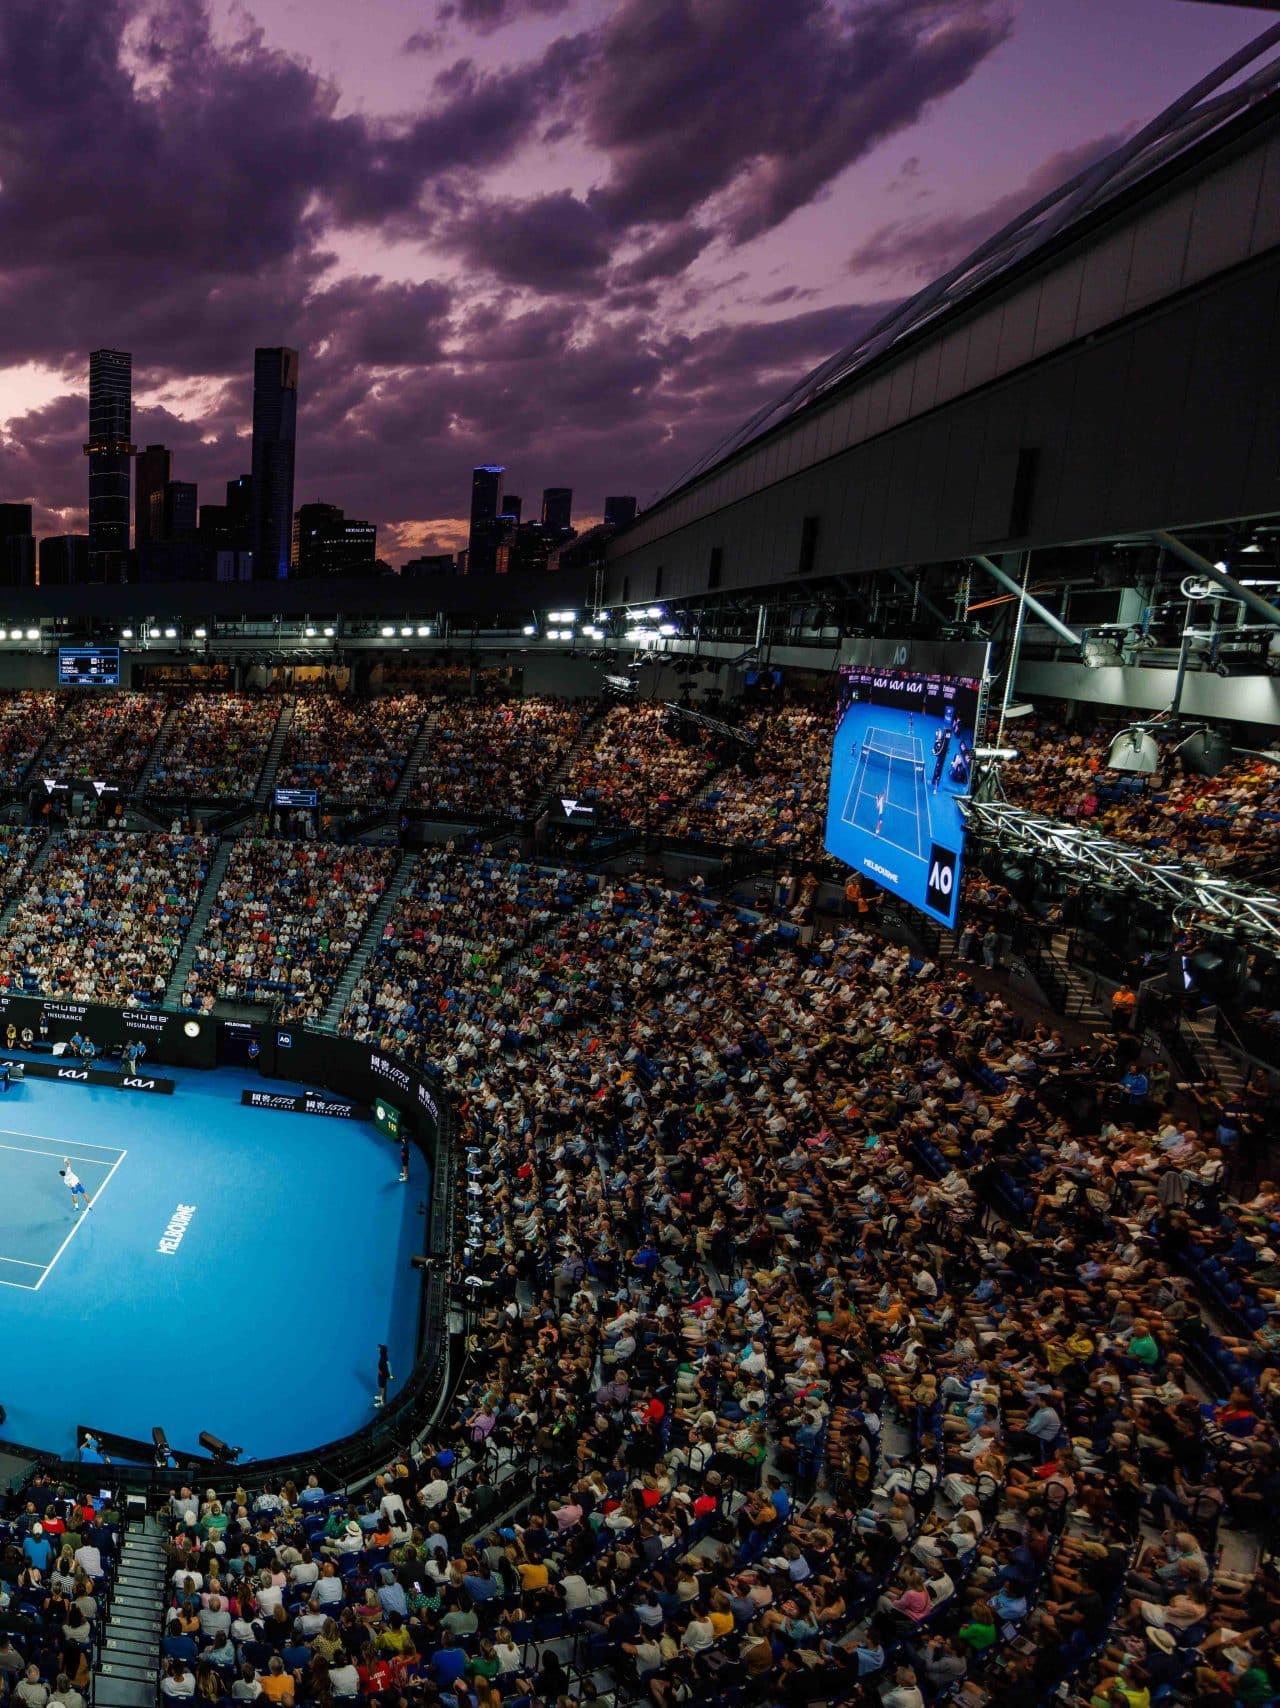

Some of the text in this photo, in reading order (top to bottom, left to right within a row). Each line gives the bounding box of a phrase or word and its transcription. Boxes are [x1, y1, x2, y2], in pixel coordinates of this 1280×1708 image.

[893, 647, 907, 665] AO
[863, 857, 899, 884] MELBOURNE
[929, 861, 953, 895] AO
[43, 1003, 87, 1014] CHUBB
[47, 1012, 83, 1022] INSURANCE
[122, 1012, 168, 1023] CHUBB
[126, 1021, 164, 1031] INSURANCE
[58, 1068, 88, 1080] KIA
[123, 1077, 155, 1089] KIA
[156, 1203, 197, 1255] MELBOURNE
